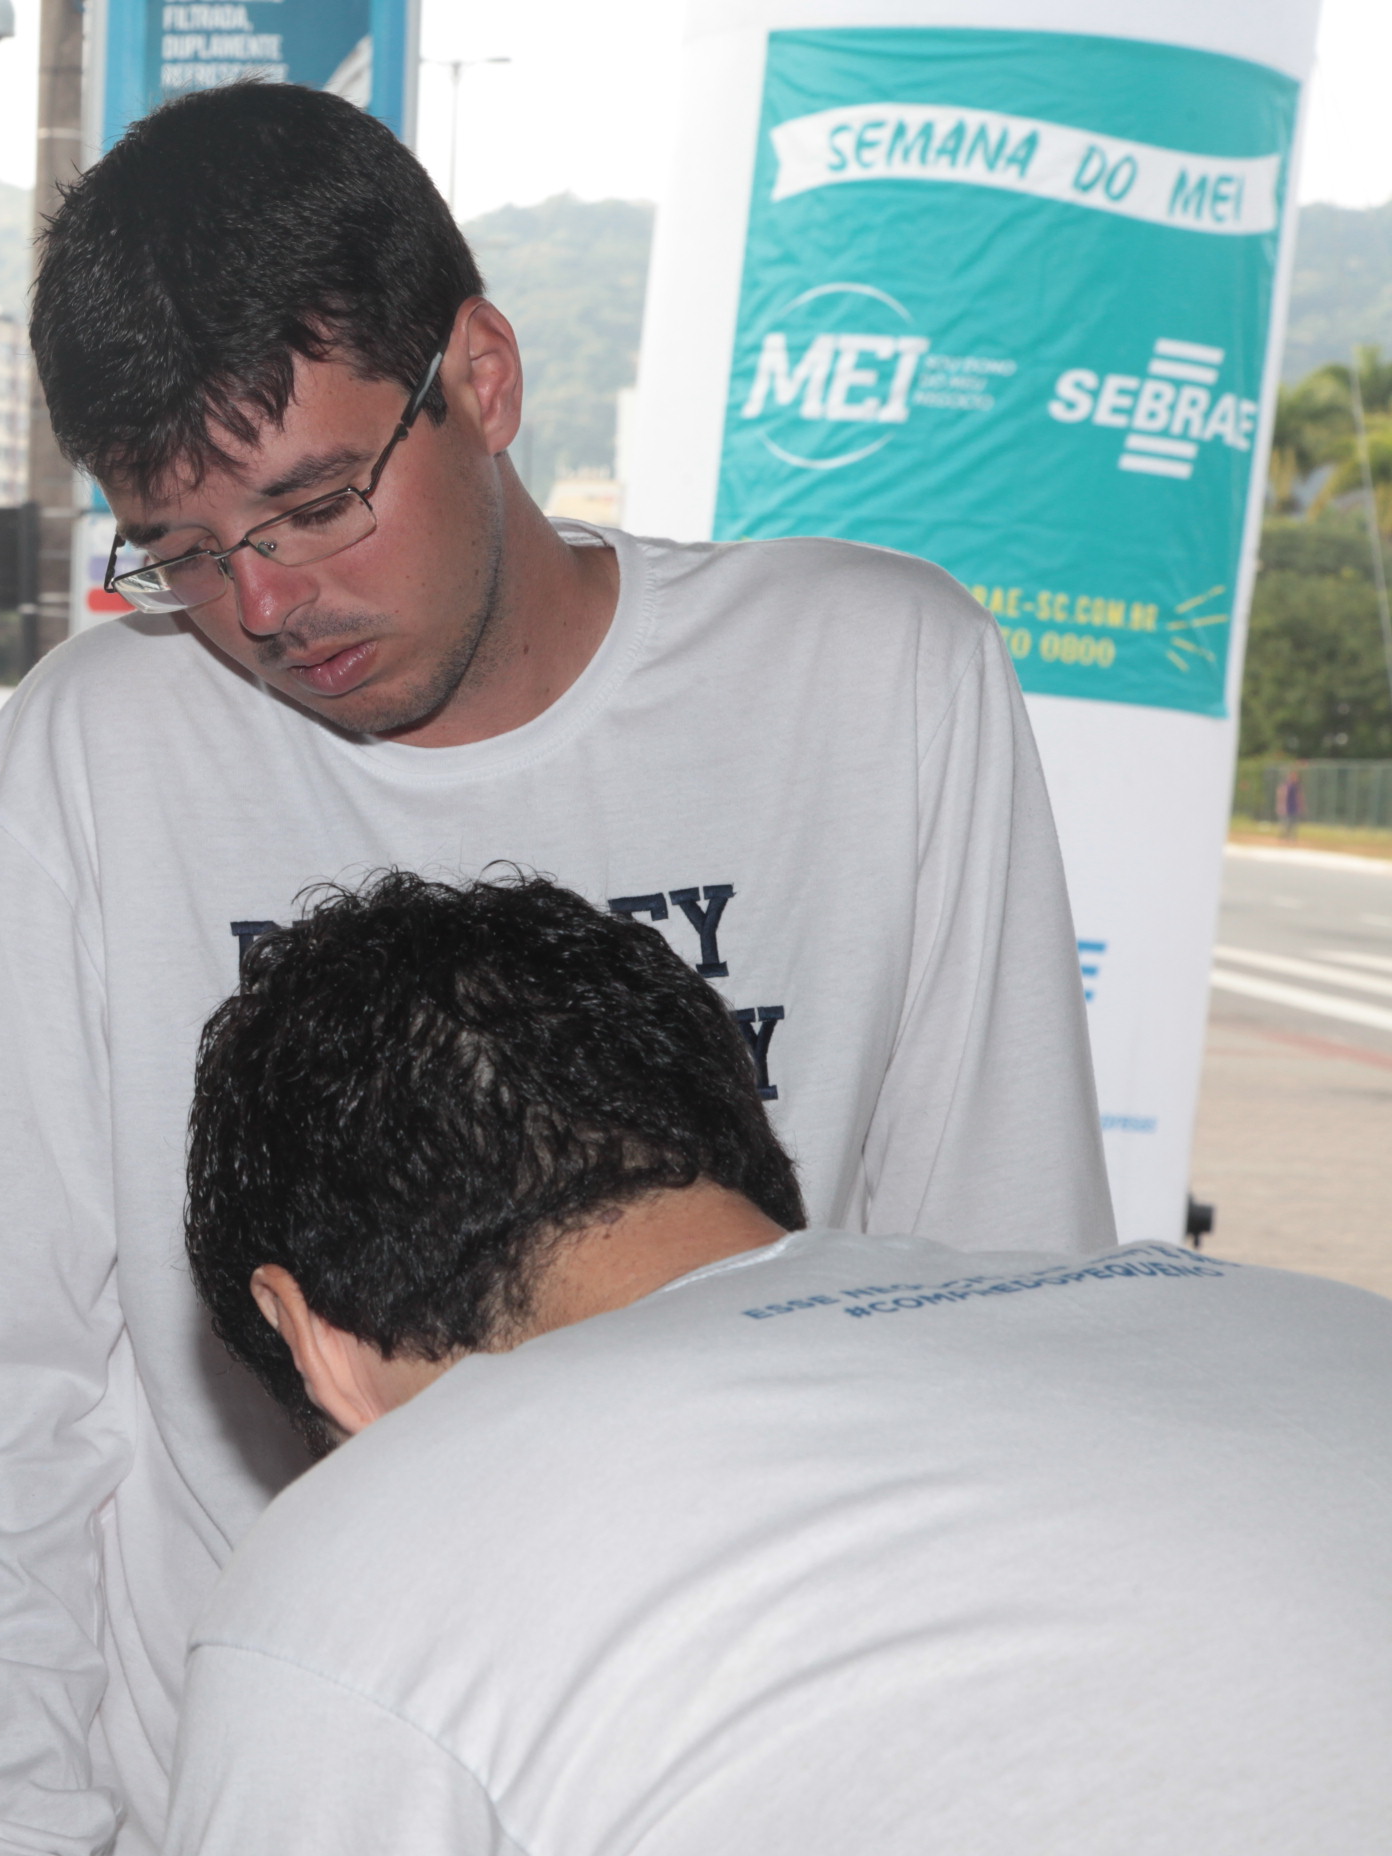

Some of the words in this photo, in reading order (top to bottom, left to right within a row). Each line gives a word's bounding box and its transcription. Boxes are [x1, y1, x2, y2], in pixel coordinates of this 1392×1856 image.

[827, 119, 1039, 180] SEMANA
[1073, 145, 1138, 201] DO
[1167, 168, 1244, 223] MEI
[742, 332, 930, 423] MEI
[1048, 367, 1258, 452] SEBRAE
[741, 1294, 840, 1319] ESSE
